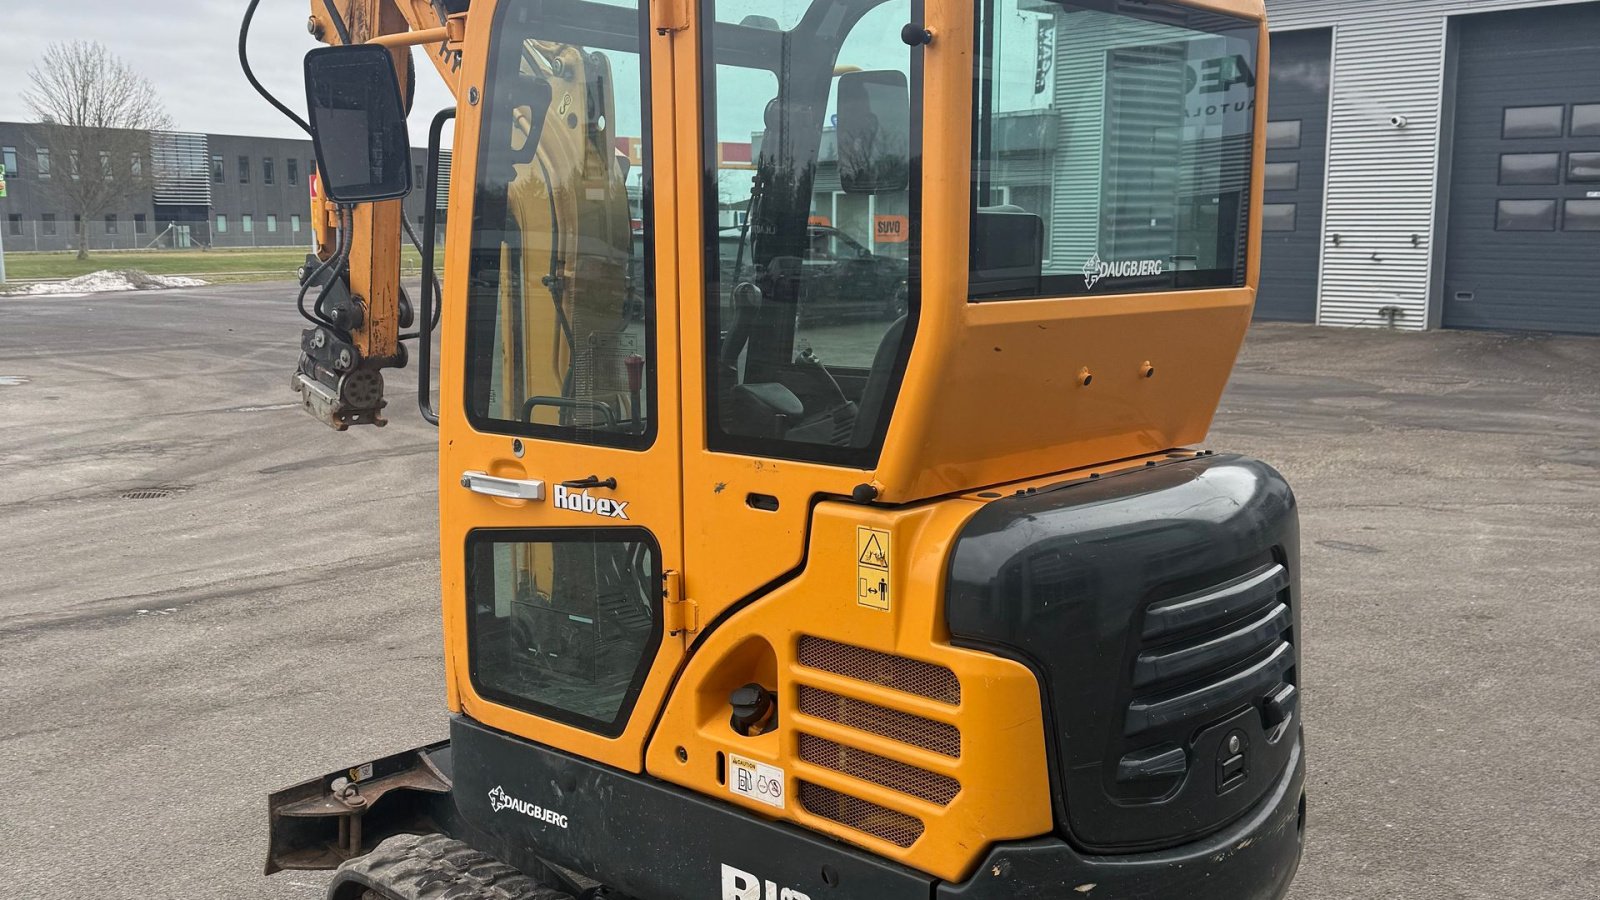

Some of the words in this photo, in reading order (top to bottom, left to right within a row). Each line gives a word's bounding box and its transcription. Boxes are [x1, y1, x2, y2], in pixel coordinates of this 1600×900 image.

[877, 220, 901, 235] SUVO
[1100, 260, 1162, 278] DAUGBJERG
[553, 483, 631, 520] Robex
[504, 794, 568, 829] DAUGBJERG
